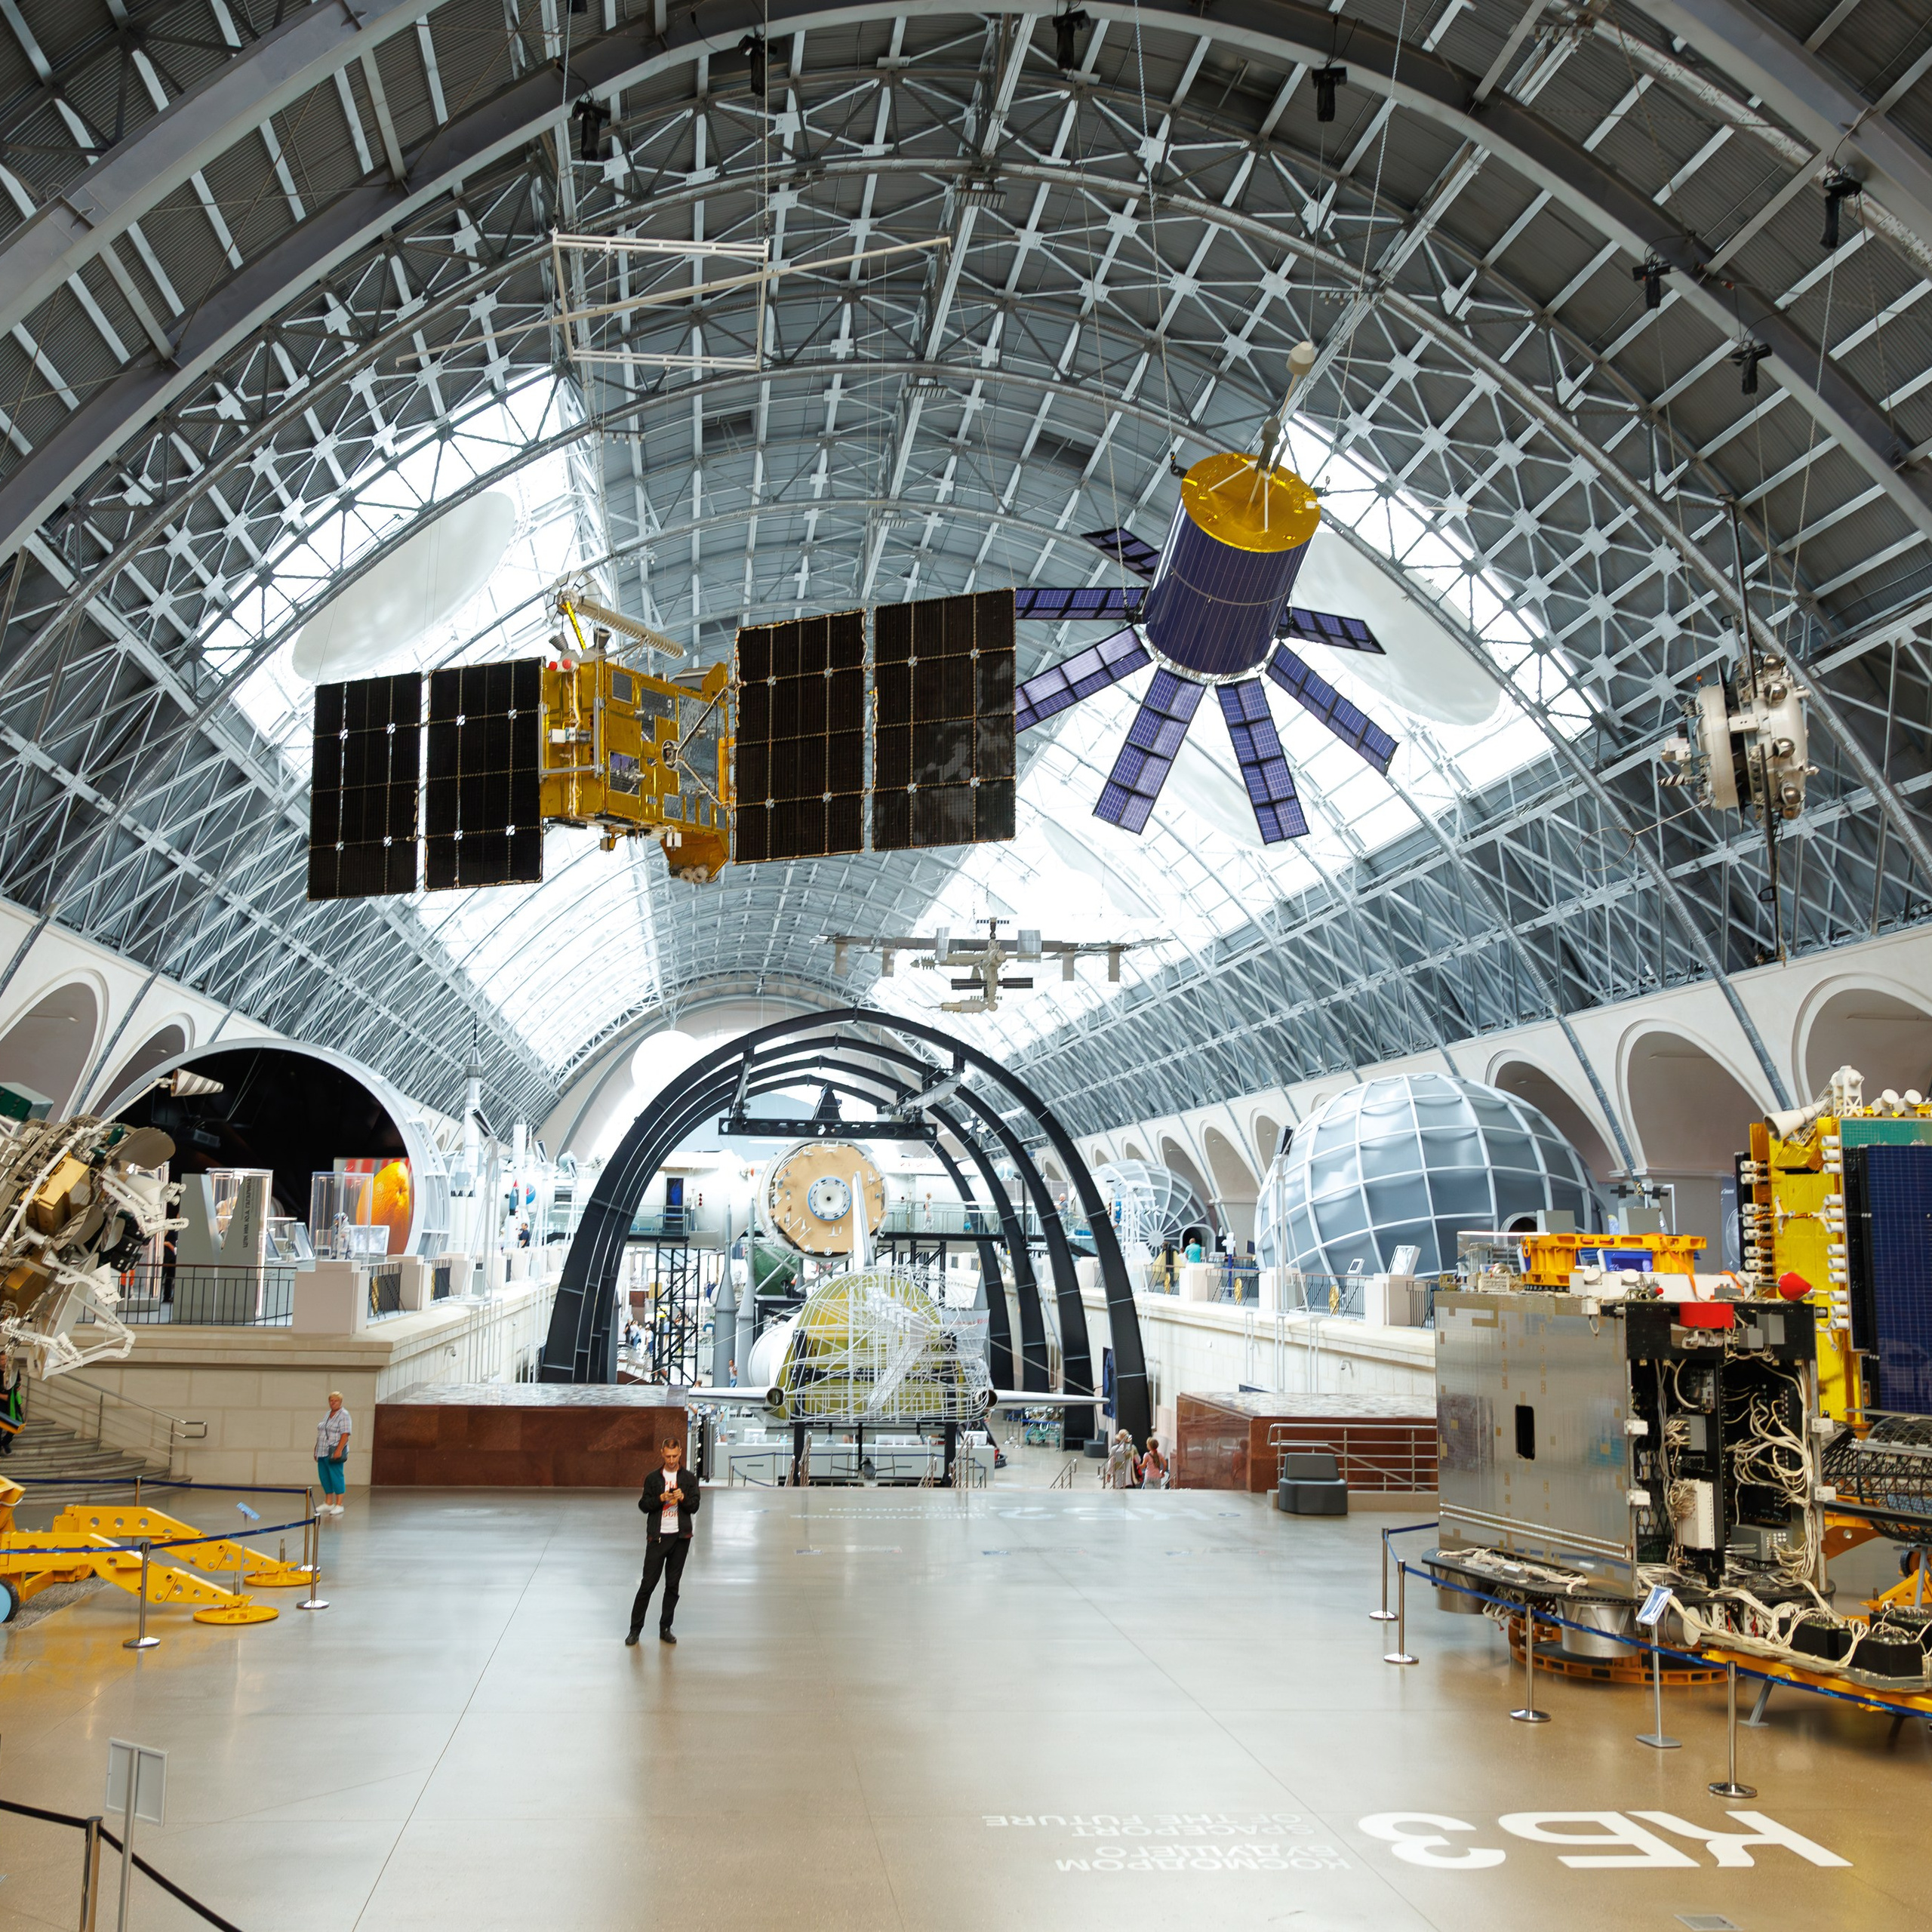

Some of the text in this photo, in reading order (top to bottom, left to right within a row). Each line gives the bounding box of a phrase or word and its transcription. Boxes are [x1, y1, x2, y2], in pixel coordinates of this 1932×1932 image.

[982, 1814, 1303, 1827] OF THE FUTURE
[1072, 1824, 1315, 1837] SPACEPORT
[1095, 1842, 1340, 1858] БУДУЩЕГО
[1054, 1857, 1352, 1872] КОСМОДРОМ
